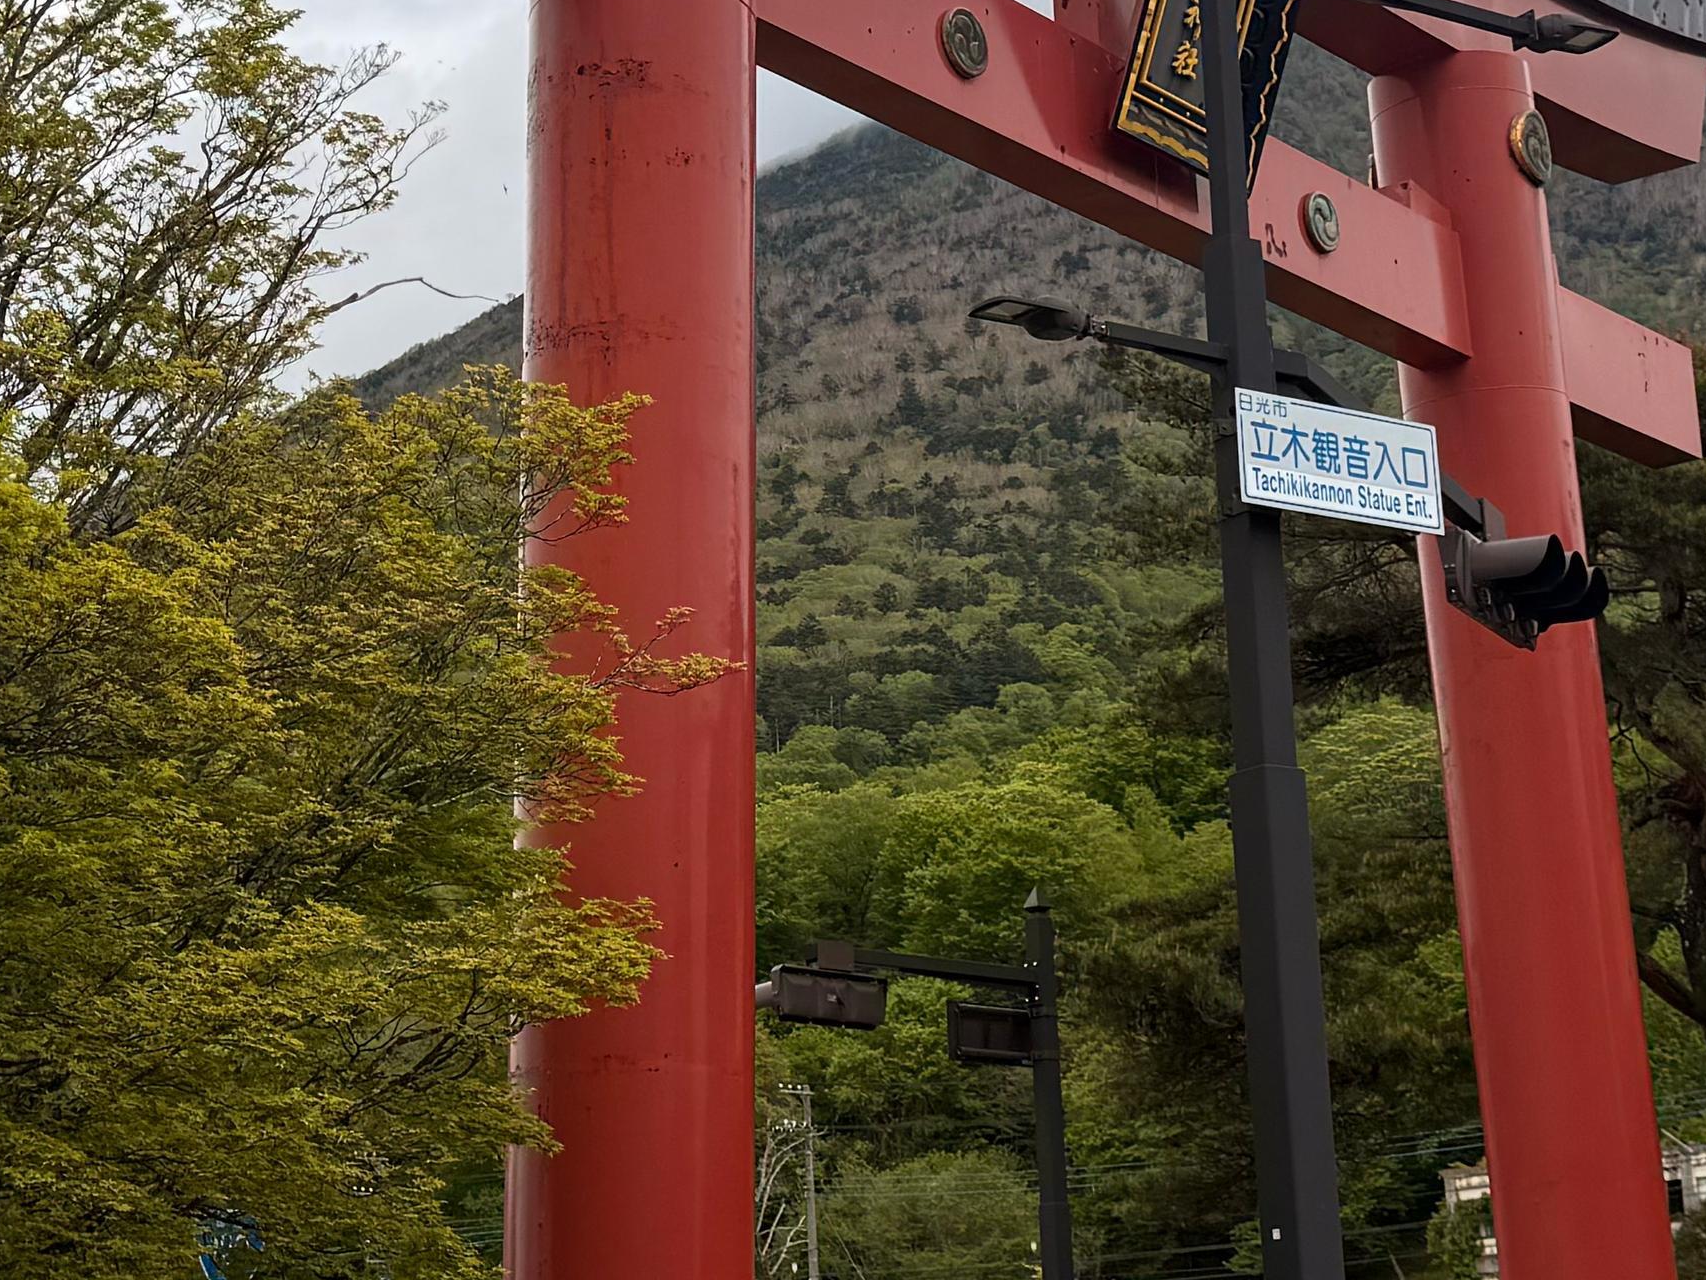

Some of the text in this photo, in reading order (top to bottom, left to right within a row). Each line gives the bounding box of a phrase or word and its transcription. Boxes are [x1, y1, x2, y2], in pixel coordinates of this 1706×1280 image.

[1239, 393, 1288, 418] 日光市
[1250, 418, 1429, 489] 立木観音入口
[1252, 467, 1433, 519] Tachikikannon Statue Ent.
